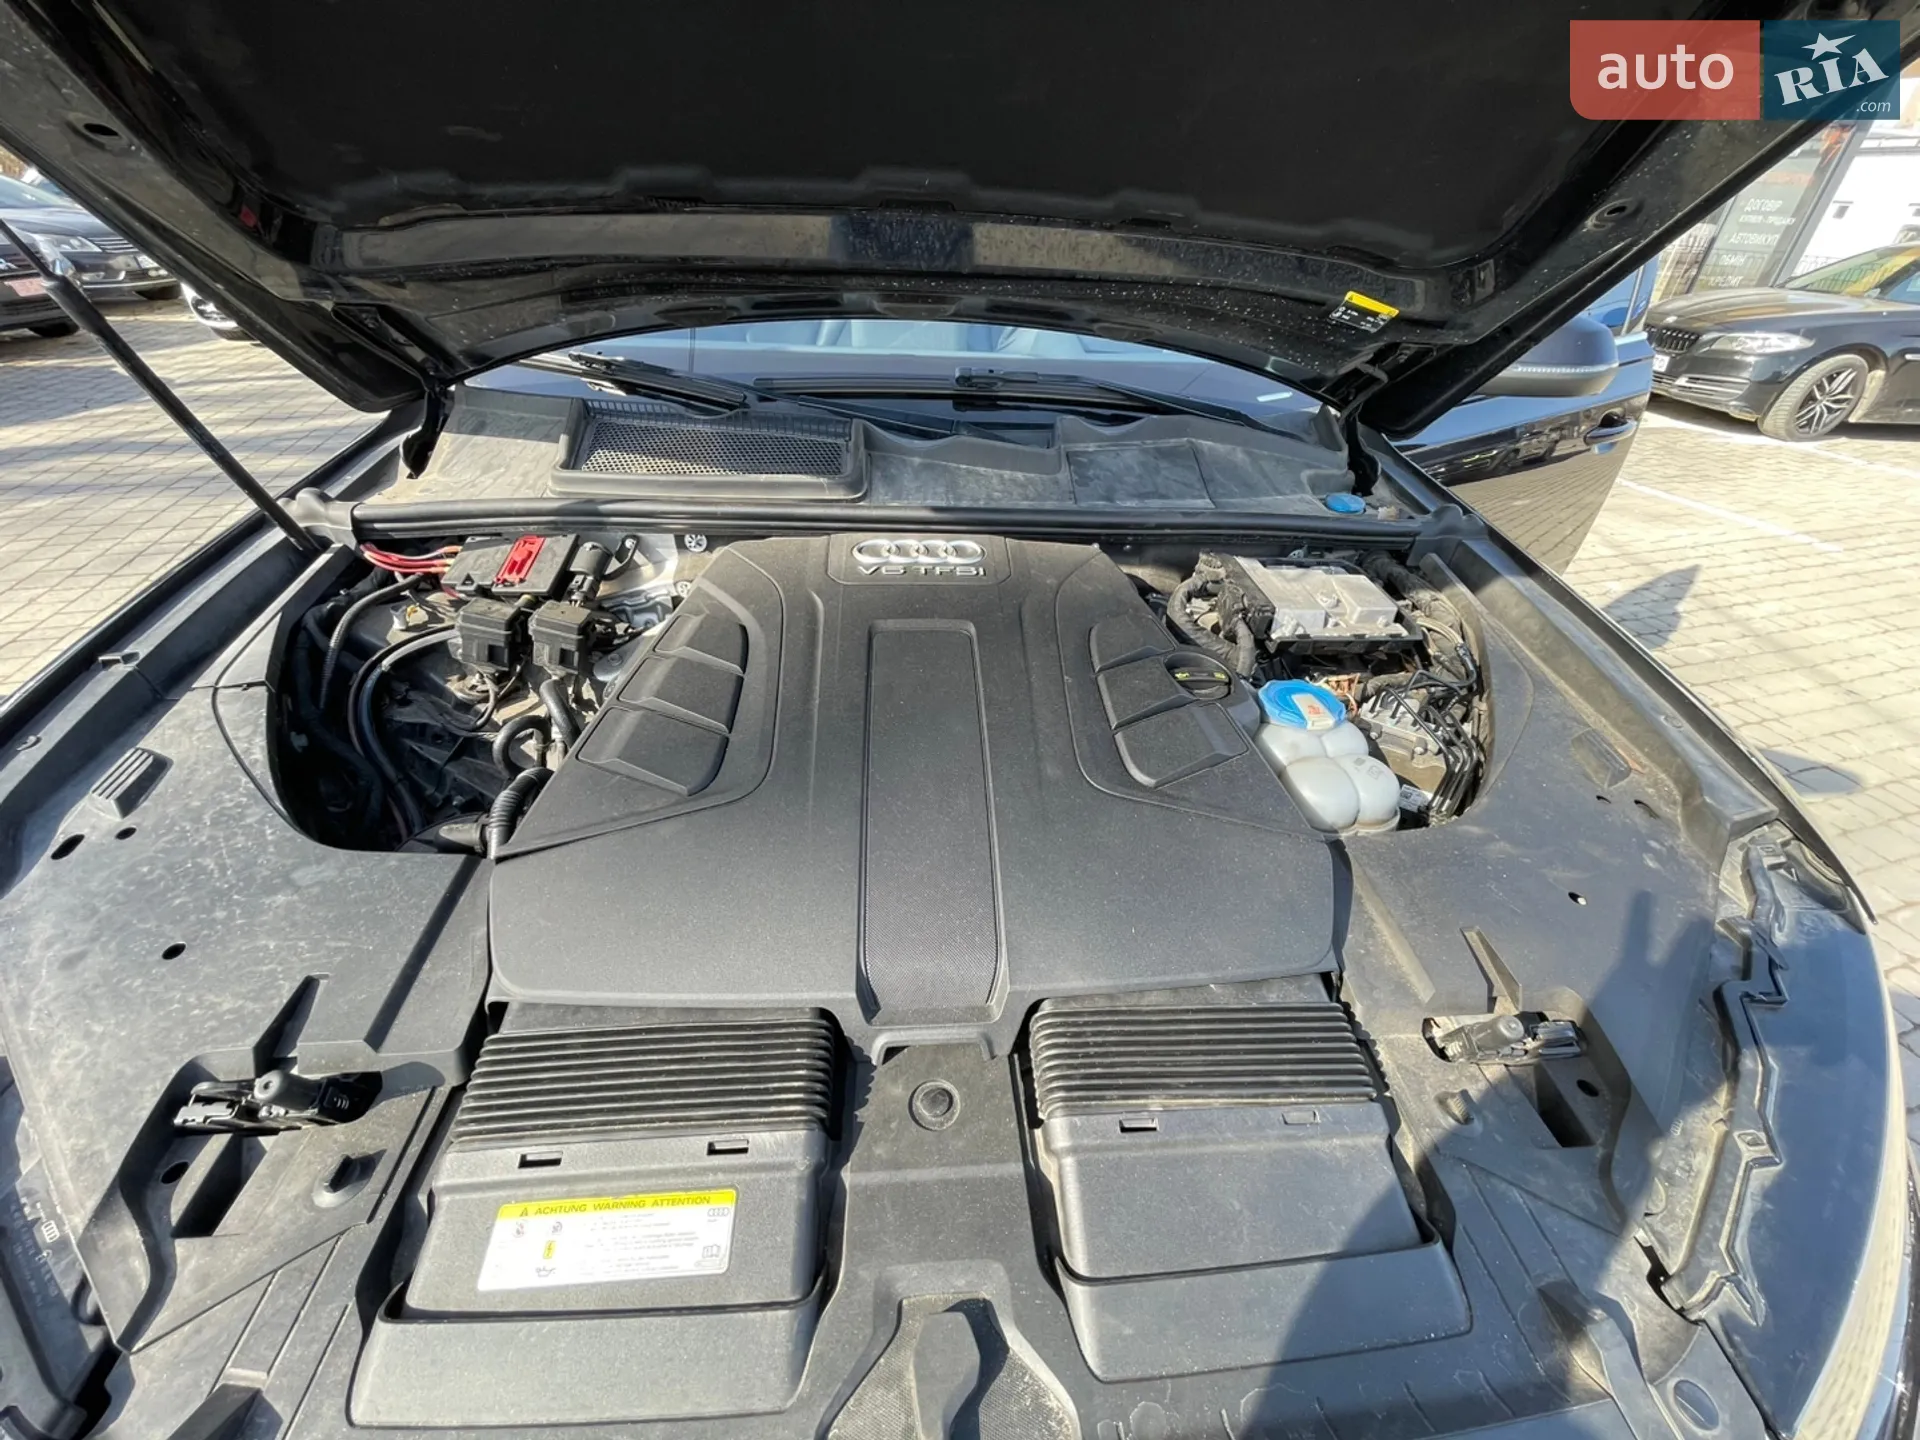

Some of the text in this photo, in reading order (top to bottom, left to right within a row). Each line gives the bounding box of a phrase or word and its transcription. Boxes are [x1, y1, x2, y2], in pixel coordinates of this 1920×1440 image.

[858, 565, 986, 576] V6 TFSI
[534, 1195, 712, 1216] ACHTUNG WARNING ATTENTION
